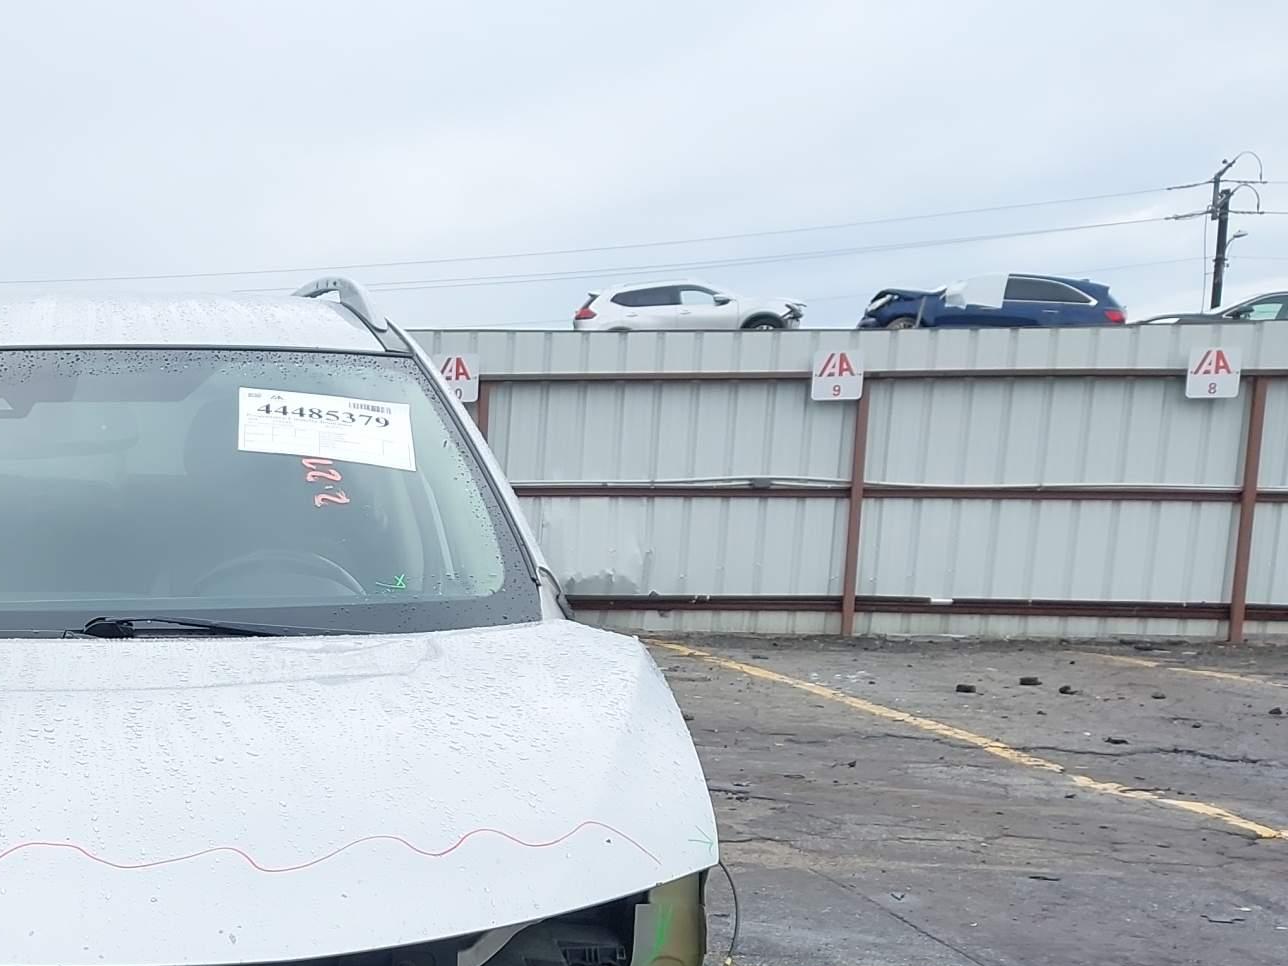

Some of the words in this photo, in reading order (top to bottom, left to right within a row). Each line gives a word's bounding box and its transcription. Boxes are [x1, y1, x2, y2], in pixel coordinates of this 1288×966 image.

[832, 384, 841, 397] 9
[1207, 382, 1218, 394] 8
[257, 403, 390, 428] 44485379
